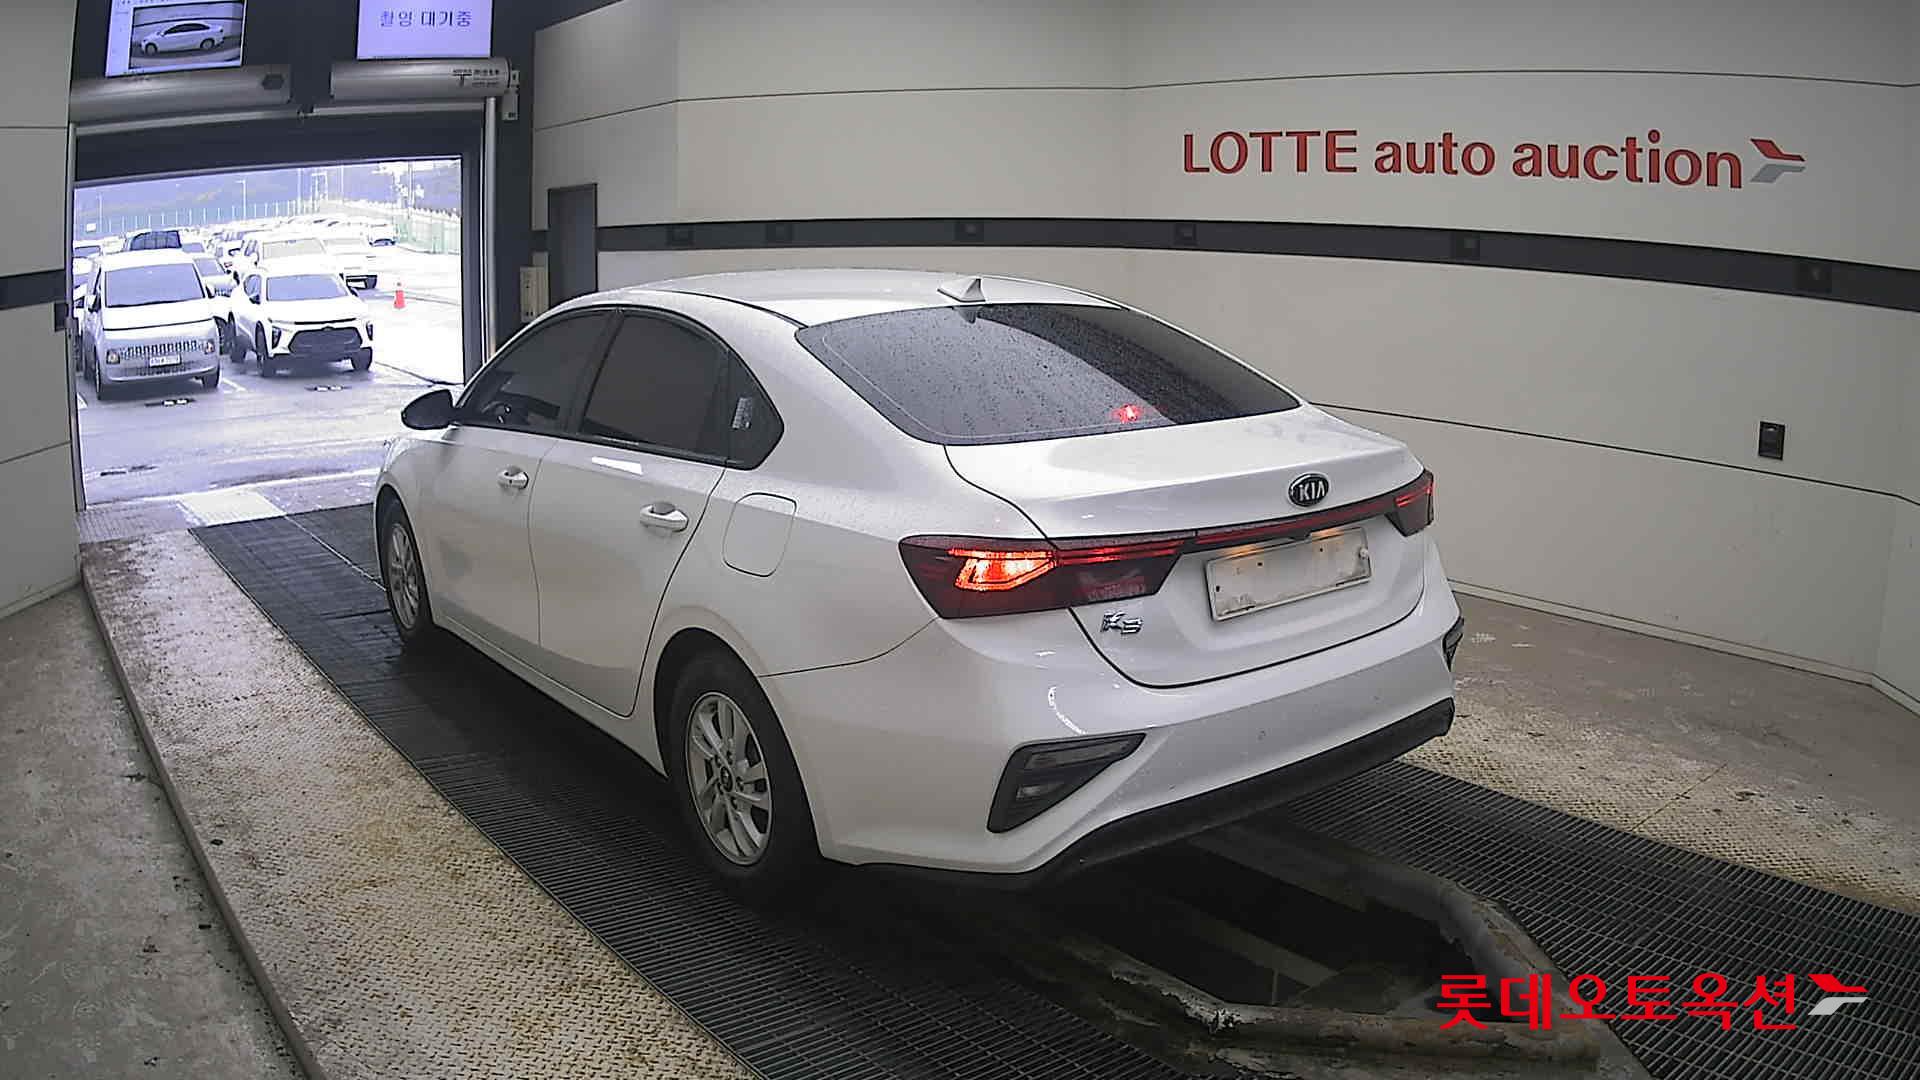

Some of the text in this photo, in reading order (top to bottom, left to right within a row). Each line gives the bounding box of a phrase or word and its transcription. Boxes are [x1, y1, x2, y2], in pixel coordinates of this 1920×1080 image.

[421, 10, 472, 27] 대기중
[1184, 129, 1743, 189] LOTTE auto auction
